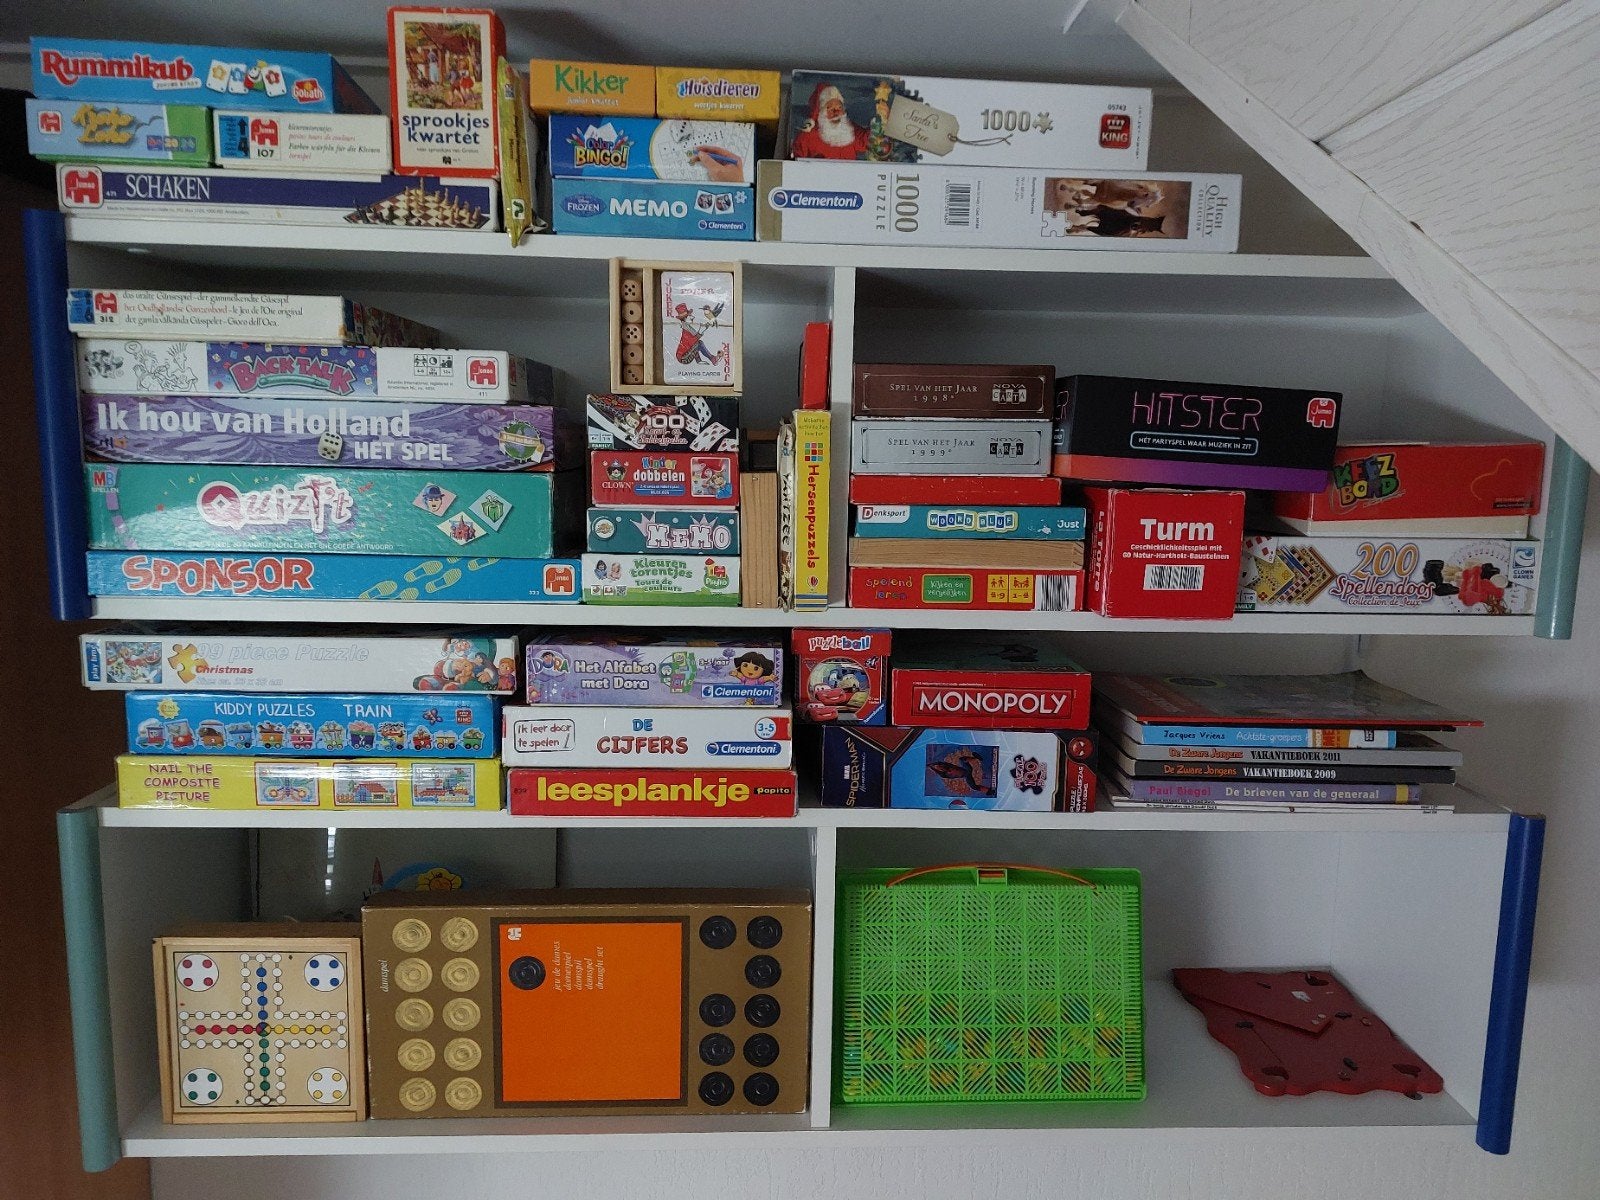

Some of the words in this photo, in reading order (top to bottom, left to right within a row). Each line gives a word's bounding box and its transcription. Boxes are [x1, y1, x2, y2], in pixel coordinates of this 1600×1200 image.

[40, 49, 194, 86] Rummikub
[555, 64, 629, 95] Kikker
[682, 79, 761, 98] Huisdieren
[402, 112, 489, 132] sprookjes
[903, 110, 939, 130] Santa's
[980, 108, 1031, 133] 1000
[408, 127, 480, 145] kwartet
[903, 125, 930, 143] Tree
[1101, 132, 1128, 143] KING
[257, 149, 275, 158] 107
[575, 147, 629, 168] BINGO!
[126, 174, 211, 200] SCHAKEN
[567, 202, 600, 213] FROZEN
[609, 198, 688, 218] MEMO
[790, 193, 859, 208] Clementoni
[876, 174, 887, 230] PUZZLE
[895, 173, 920, 233] 1000
[1204, 184, 1221, 238] QUALITY
[1214, 195, 1229, 230] HIGH
[100, 315, 114, 323] 312
[890, 383, 911, 391] SPEL
[914, 384, 931, 392] VAN
[955, 384, 978, 394] JAAR
[992, 389, 1027, 404] CARTA
[1132, 391, 1263, 431] HITSTER
[98, 403, 128, 431] Ik
[139, 403, 200, 432] hou
[212, 411, 273, 434] van
[284, 408, 410, 438] Holland
[641, 414, 685, 429] 100
[888, 437, 909, 445] SPEL
[953, 438, 975, 448] JAAR
[1152, 438, 1186, 446] PARTYSPEL
[1187, 440, 1207, 448] WAAR
[1208, 441, 1232, 449] MUZIEK
[1233, 442, 1241, 450] IN
[402, 442, 453, 461] SPEL
[990, 443, 1024, 458] CARTA
[641, 457, 678, 470] Kinder
[93, 471, 115, 486] MB
[633, 469, 686, 482] dobbelen
[808, 464, 820, 569] Hersenpuzzels
[862, 506, 906, 520] Denksport
[929, 513, 974, 527] WOORD
[978, 514, 1014, 528] BLUF
[1057, 519, 1079, 529] Just
[1140, 518, 1215, 541] Turm
[646, 524, 732, 549] MEMO
[1131, 544, 1208, 552] Geschicklichkeitsspiel
[634, 558, 687, 569] Kleuren
[1351, 543, 1420, 579] 200
[122, 555, 314, 595] SPONSOR
[630, 567, 693, 579] torentjes
[662, 578, 672, 586] de
[865, 577, 913, 589] spelend
[1330, 575, 1436, 603] Spellendoos
[875, 590, 907, 600] leren
[1349, 596, 1387, 606] Collection
[808, 635, 871, 651] puzzleball
[229, 645, 288, 663] piece
[295, 644, 369, 661] Puzzle
[195, 664, 253, 675] Christmas
[574, 660, 601, 674] Het
[603, 660, 657, 674] Alfabet
[581, 678, 610, 689] met
[613, 676, 650, 690] Dora
[714, 687, 773, 696] Clementoni
[214, 702, 253, 716] KIDDY
[257, 703, 315, 717] PUZZLES
[343, 704, 392, 718] TRAIN
[919, 691, 1067, 714] MONOPOLY
[530, 723, 548, 734] leer
[550, 723, 572, 732] door
[632, 719, 654, 731] DE
[757, 723, 774, 732] 3-5
[1164, 730, 1195, 740] Jacques
[1200, 732, 1225, 740] Vriens
[518, 738, 528, 748] te
[597, 736, 689, 754] CIJFERS
[721, 744, 777, 754] Clementoni
[1168, 748, 1180, 757] De
[1182, 749, 1209, 758] Zware
[1211, 748, 1244, 760] Jongens
[1251, 751, 1321, 762] VAKANTIEBOEK
[1322, 752, 1341, 762] 2011
[149, 763, 182, 774] NAIL
[187, 764, 212, 774] THE
[845, 737, 860, 807] SPIDER-MAN
[1163, 765, 1176, 774] De
[1177, 766, 1202, 775] Zware
[1204, 766, 1237, 777] Jongens
[1243, 767, 1313, 779] VAKANTIEBOEK
[1314, 768, 1336, 779] 2009
[144, 777, 220, 788] COMPOSITE
[156, 791, 210, 802] PICTURE
[537, 776, 750, 807] leesplankje
[1149, 786, 1173, 795] Paul
[1177, 787, 1211, 797] Biegel
[1225, 787, 1240, 797] De
[1243, 787, 1286, 798] brieven
[1290, 790, 1309, 798] van
[1313, 788, 1327, 798] de
[1330, 789, 1379, 801] generaal
[553, 941, 561, 965] dames
[598, 946, 606, 961] set
[380, 960, 389, 993] damspel
